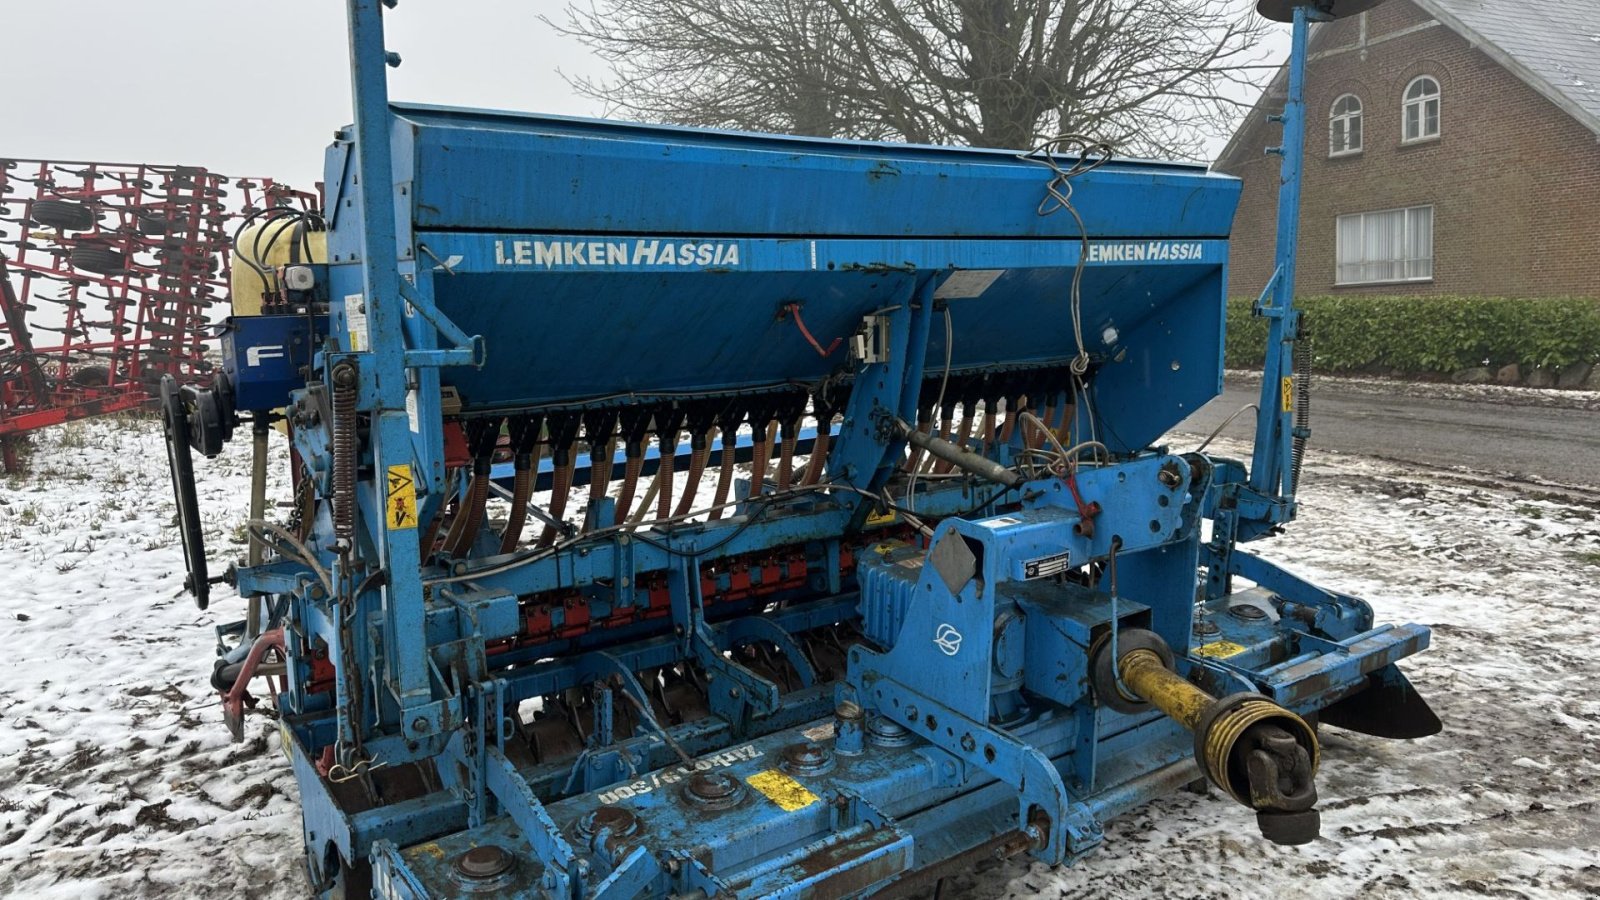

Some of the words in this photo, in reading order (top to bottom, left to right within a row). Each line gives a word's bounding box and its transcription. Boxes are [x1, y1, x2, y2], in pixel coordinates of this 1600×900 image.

[495, 240, 628, 269] LEMKEN
[631, 239, 740, 266] HASSIA
[1146, 241, 1202, 261] HASSIA
